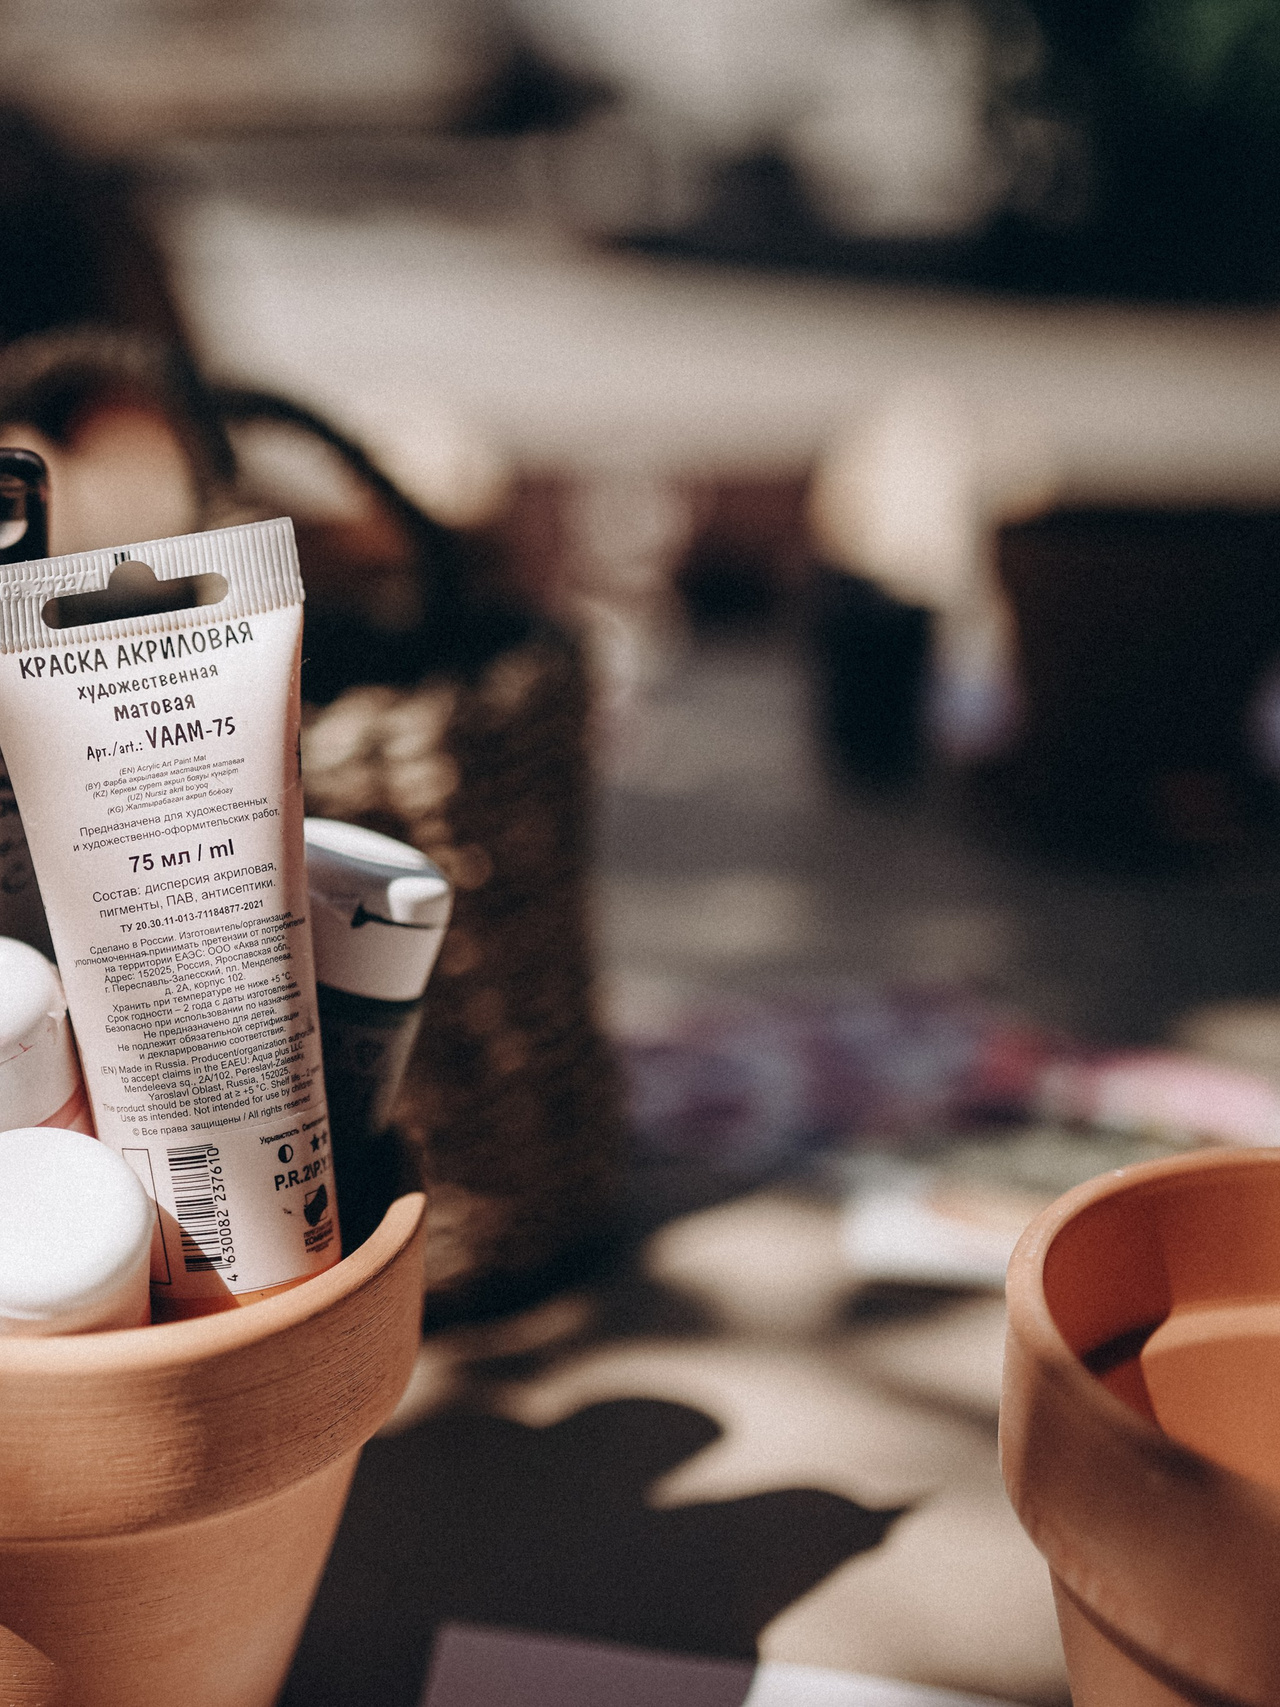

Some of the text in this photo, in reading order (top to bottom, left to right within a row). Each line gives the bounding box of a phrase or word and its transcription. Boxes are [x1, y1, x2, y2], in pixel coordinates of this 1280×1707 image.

[18, 618, 254, 680] КРАСКА АКРИЛОВАЯ
[76, 663, 221, 705] художественная
[112, 693, 196, 722] матовая
[84, 712, 237, 763] Арт./art.: VAAM-75
[118, 765, 137, 777] (EN)
[135, 761, 162, 774] Acrylic
[172, 755, 193, 766] Paint
[192, 752, 207, 762] Mat
[83, 780, 102, 792] (BY)
[101, 776, 127, 789] Фарба
[91, 789, 109, 801] (KZ)
[126, 792, 144, 804] (UZ)
[78, 796, 269, 840] Предназначена для художественных
[106, 804, 125, 816] (KG)
[80, 810, 251, 853] художественно-оформительских
[250, 805, 281, 822] работ.
[127, 852, 155, 874] 75
[159, 850, 191, 868] мл
[206, 838, 235, 859] ml
[90, 861, 278, 904] Состав: дисперсия акриловая,
[97, 877, 276, 921] пигменты, ПАВ, антисептики.
[119, 898, 265, 934] ТУ 20.30.11-013-71184877-2021
[88, 940, 131, 957] Сделано
[138, 932, 178, 948] России.
[200, 931, 248, 948] претензии
[103, 971, 137, 986] Адрес:
[138, 964, 176, 981] 152025,
[176, 958, 212, 974] Россия,
[213, 945, 273, 967] Ярославская
[117, 956, 173, 974] территории
[173, 948, 206, 963] ЕАЭС:
[206, 943, 232, 956] ООО
[111, 965, 224, 995] Переславль-Залесский,
[193, 977, 226, 991] корпус
[227, 971, 246, 983] 102.
[106, 1012, 130, 1025] Срок
[129, 1008, 173, 1022] годности
[190, 1001, 211, 1013] года
[221, 994, 246, 1007] даты
[111, 999, 152, 1015] Хранить
[152, 998, 171, 1009] при
[172, 986, 233, 1006] температуре
[245, 978, 269, 990] ниже
[104, 1019, 152, 1034] Безопасно
[153, 1018, 173, 1029] при
[173, 1004, 244, 1025] использовании
[142, 1006, 278, 1040] Не предназначено для детей.
[116, 1042, 130, 1053] Не
[131, 1038, 177, 1052] подлежит
[178, 1024, 243, 1045] обязательной
[146, 1039, 228, 1061] декларированию
[118, 1063, 141, 1074] Made
[154, 1057, 188, 1071] Russia.
[130, 1071, 161, 1085] accept
[163, 1067, 191, 1080] claims
[203, 1062, 219, 1073] the
[219, 1055, 250, 1070] EAEU:
[250, 1049, 274, 1065] Aqua
[123, 1079, 177, 1093] Mendeleeva
[147, 1087, 190, 1102] Yaroslavl
[193, 1081, 225, 1097] Oblast,
[225, 1074, 259, 1091] Russia,
[115, 1102, 146, 1114] product
[146, 1099, 177, 1111] should
[178, 1097, 191, 1107] be
[191, 1091, 222, 1105] stored
[120, 1113, 136, 1123] Use
[149, 1108, 191, 1121] intended.
[192, 1104, 211, 1116] Not
[211, 1096, 251, 1113] intended
[250, 1093, 264, 1105] for
[263, 1090, 280, 1101] use
[141, 1126, 158, 1136] Все
[159, 1125, 188, 1136] права
[189, 1115, 241, 1133] защищены
[245, 1109, 260, 1120] All
[206, 1147, 239, 1282] 4 630082 237610
